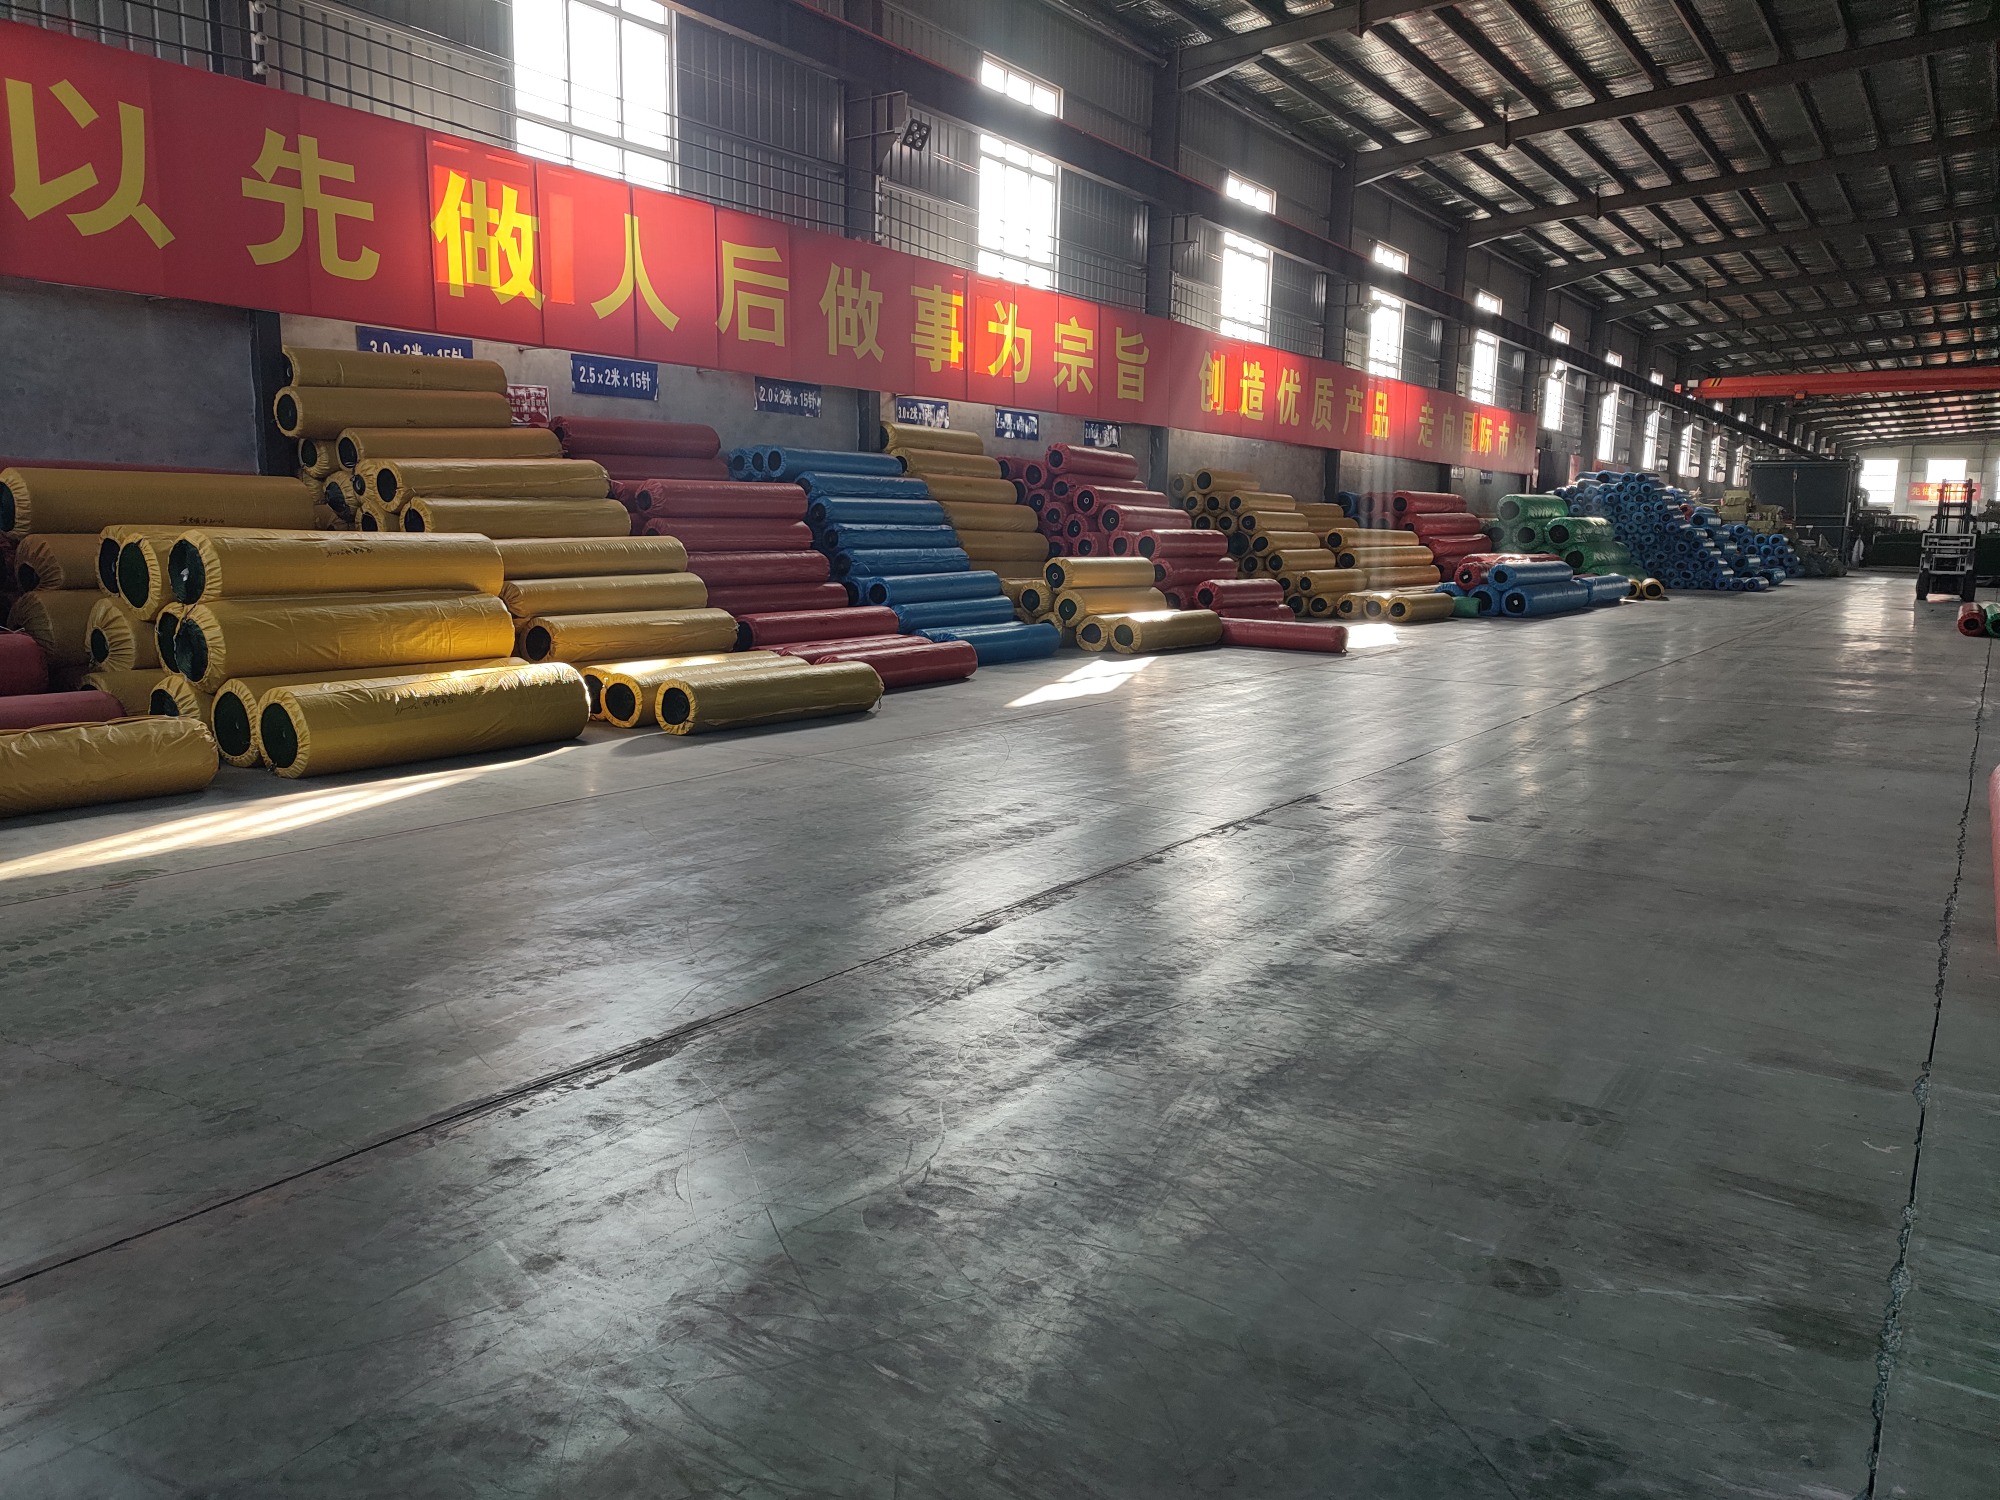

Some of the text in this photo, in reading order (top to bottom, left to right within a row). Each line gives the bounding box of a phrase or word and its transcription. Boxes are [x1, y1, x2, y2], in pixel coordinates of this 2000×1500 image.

[5, 79, 1150, 403] 以先做人后做事为宗旨
